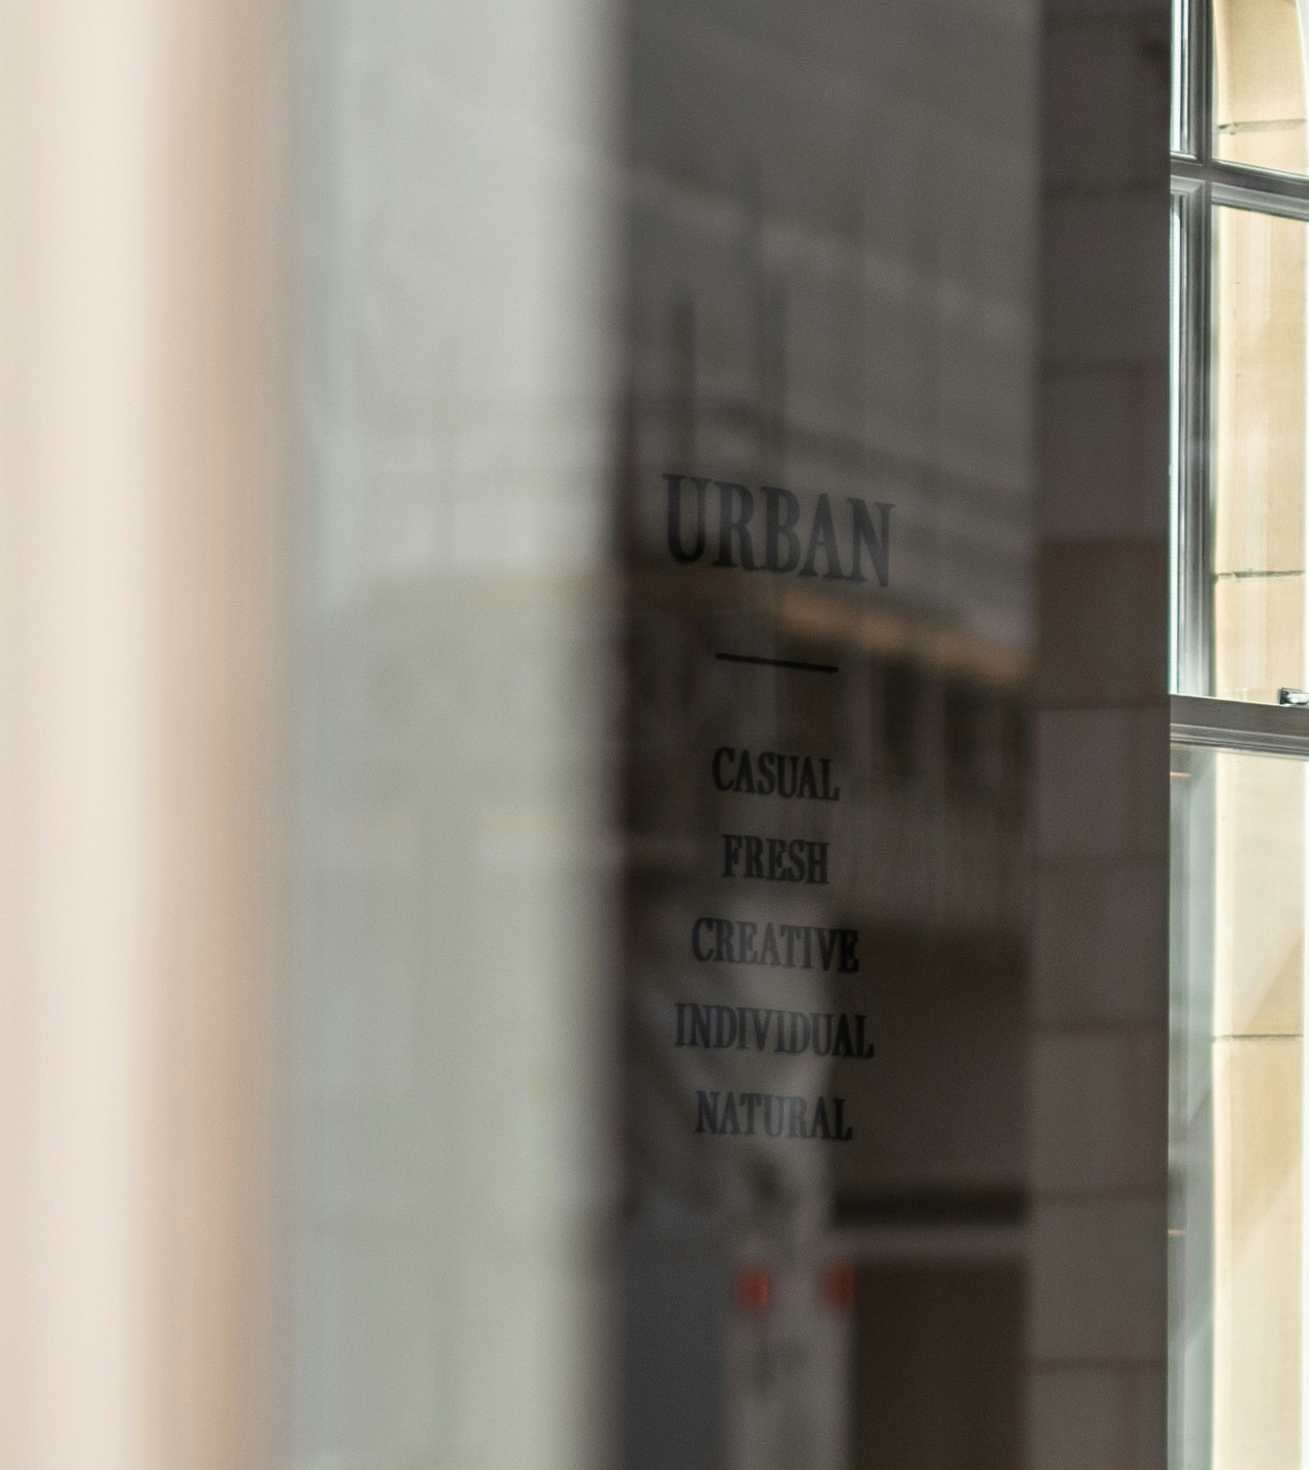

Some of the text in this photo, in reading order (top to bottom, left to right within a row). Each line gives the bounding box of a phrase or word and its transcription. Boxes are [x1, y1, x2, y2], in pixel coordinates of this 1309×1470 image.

[662, 473, 896, 587] URBAN
[712, 746, 839, 800] CASUAL
[721, 834, 829, 884] FRESH
[691, 917, 859, 973] CREATIVE
[675, 1003, 874, 1058] INDIVIDUAL
[694, 1090, 853, 1141] NATURAL
